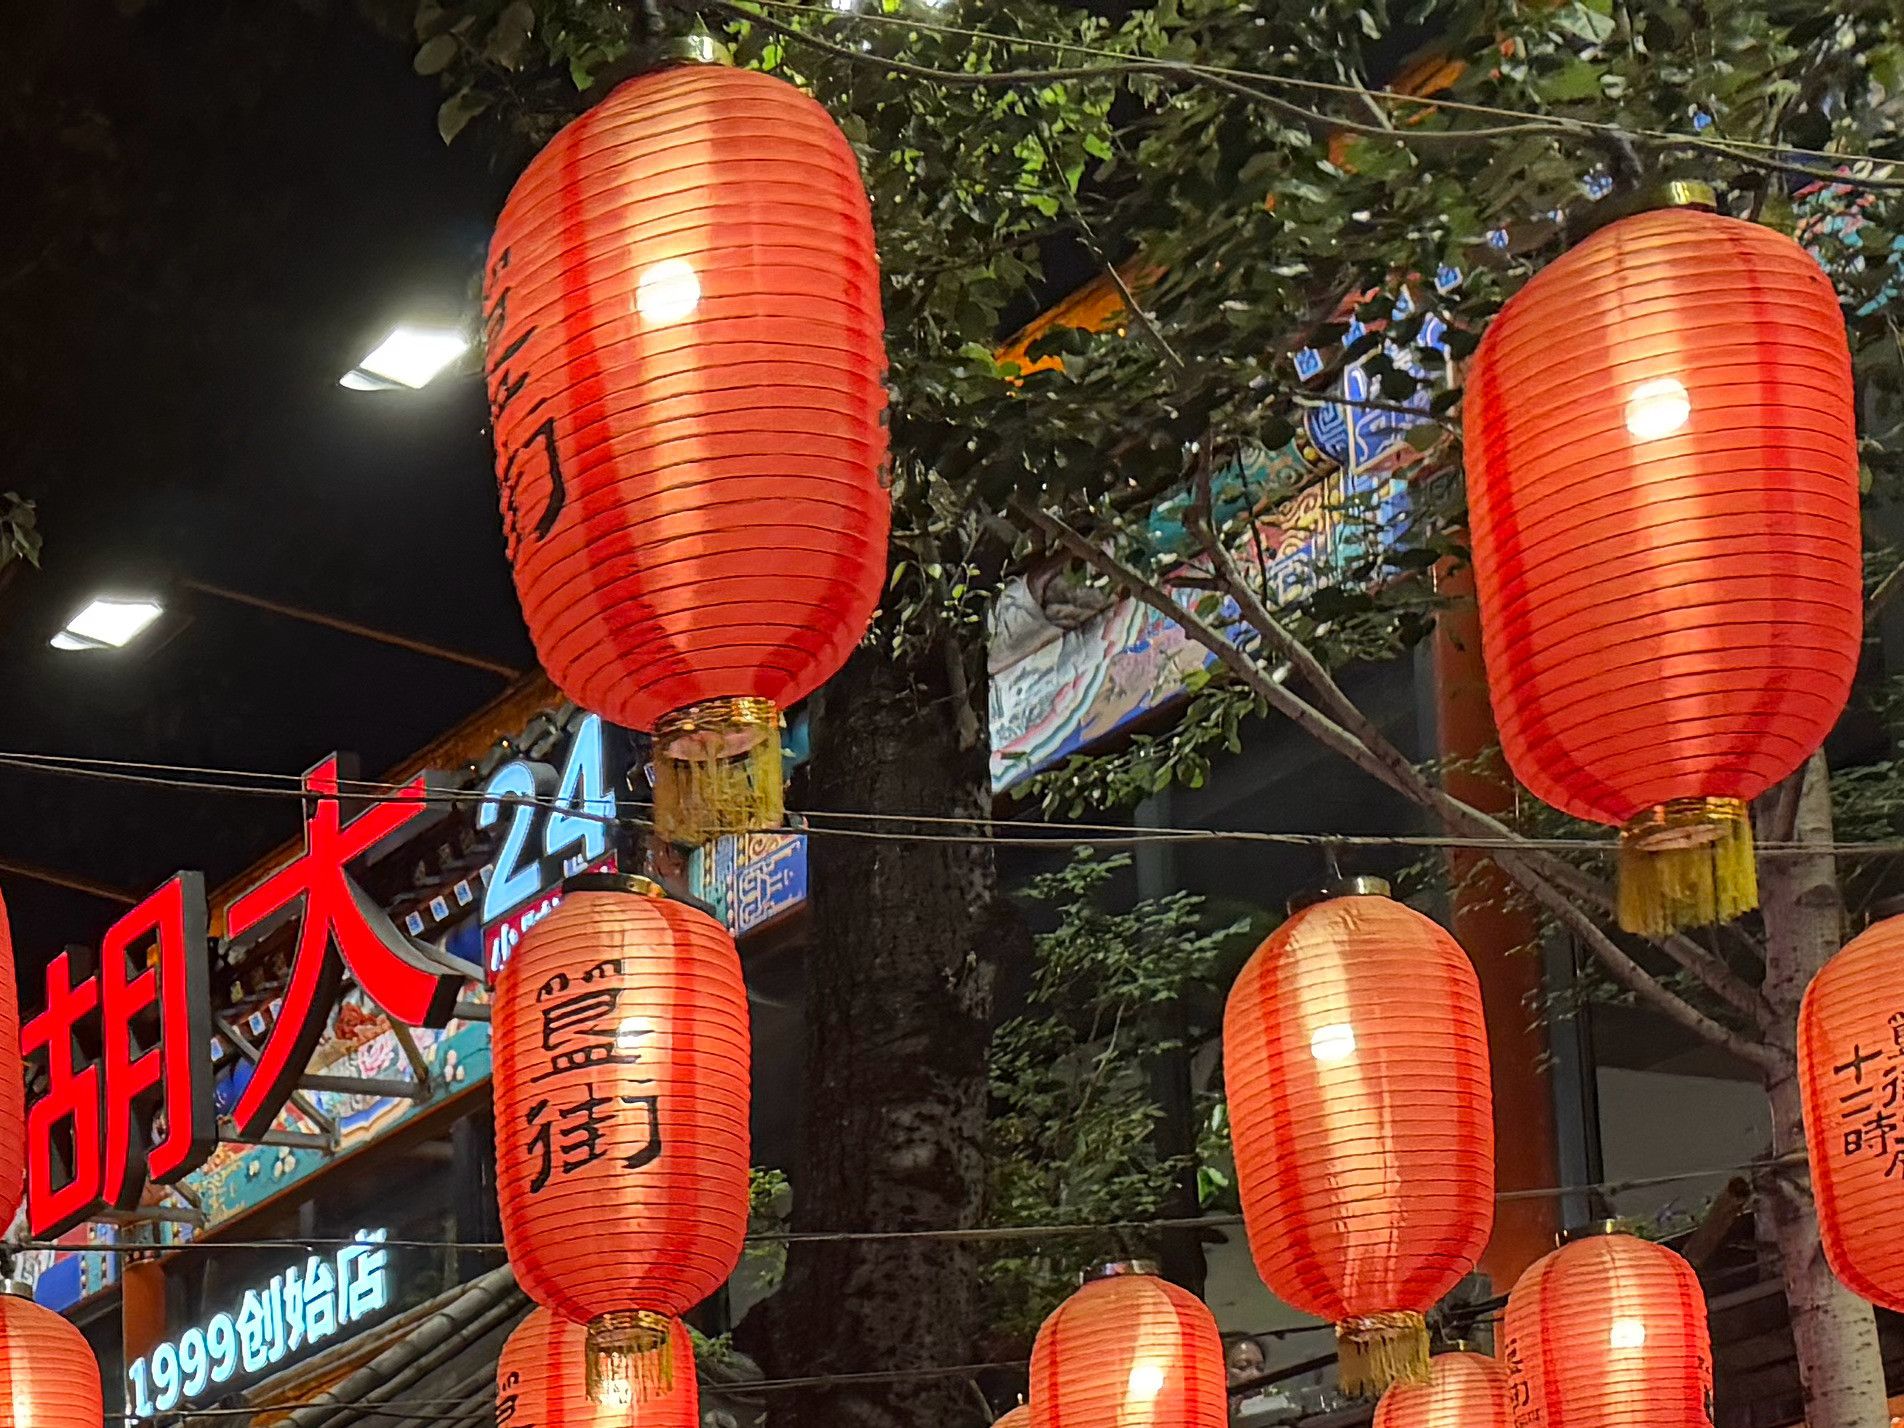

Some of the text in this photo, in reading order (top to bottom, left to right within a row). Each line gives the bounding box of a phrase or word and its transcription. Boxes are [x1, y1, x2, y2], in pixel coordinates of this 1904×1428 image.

[478, 715, 616, 924] 24
[20, 762, 437, 1236] 胡大
[528, 958, 662, 1193] 簋街
[128, 1229, 388, 1416] 1999创始店
